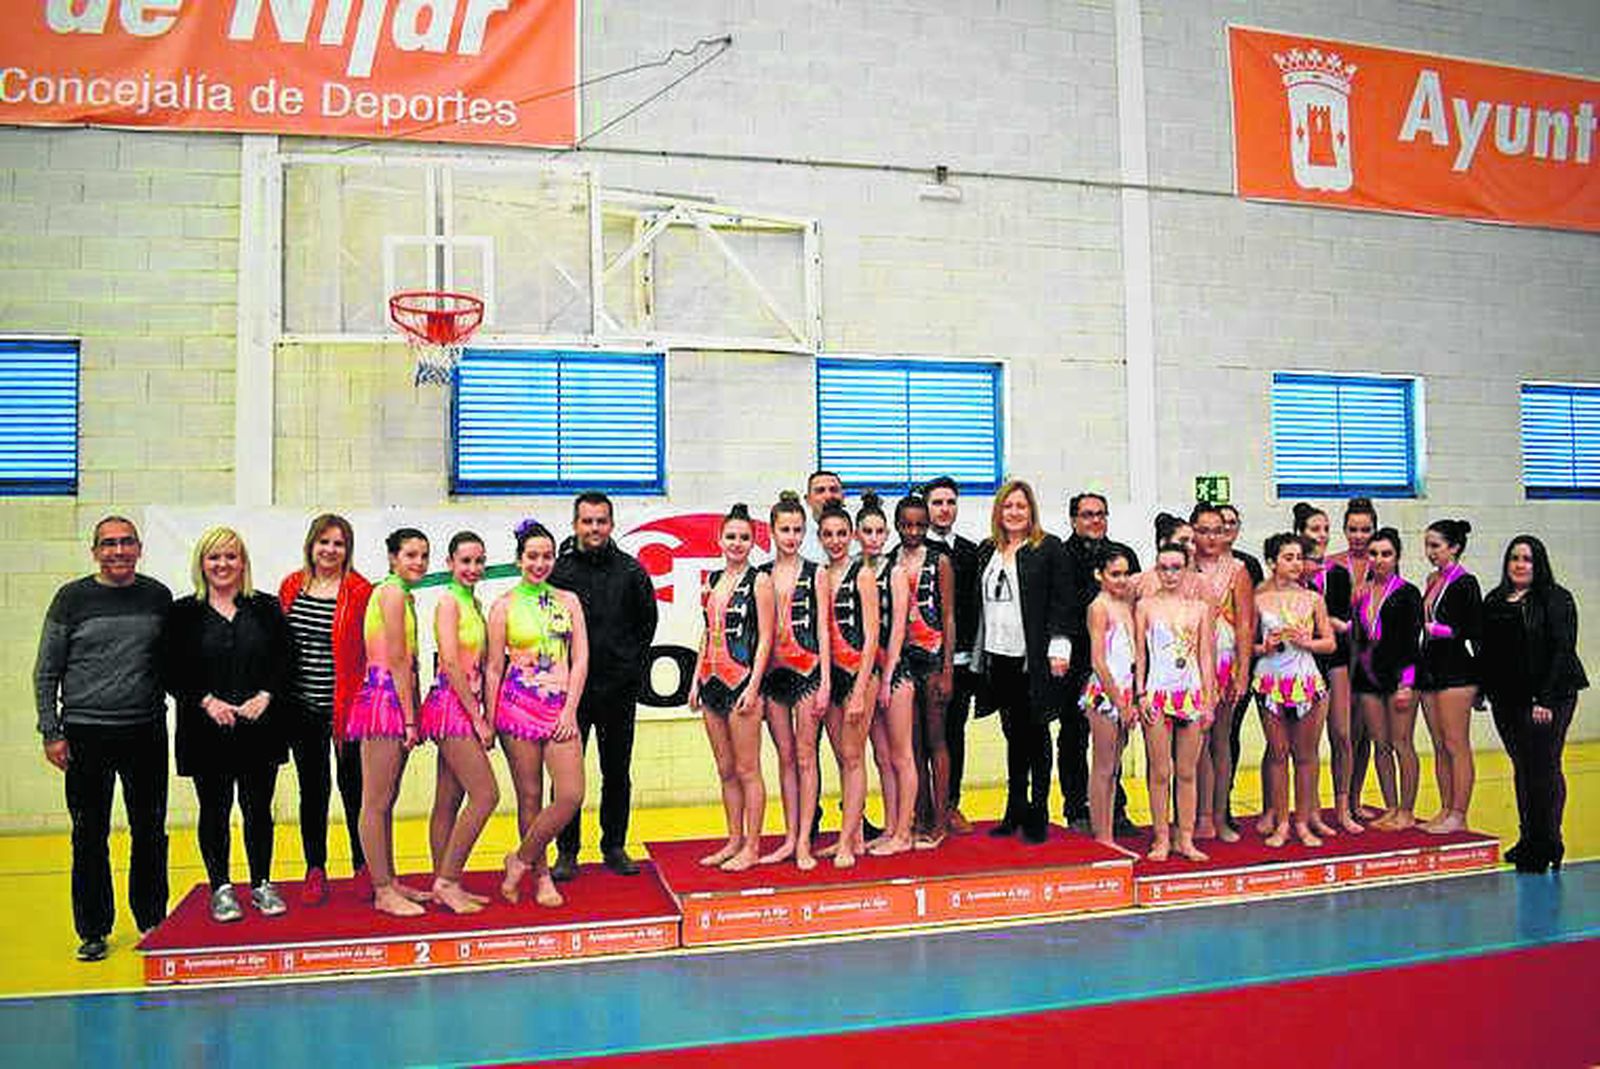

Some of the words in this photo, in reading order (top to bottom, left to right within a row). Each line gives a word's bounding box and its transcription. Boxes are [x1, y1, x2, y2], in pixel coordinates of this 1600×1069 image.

[0, 67, 234, 115] Concejalía
[250, 78, 304, 115] de
[321, 82, 519, 126] Deportes
[1398, 68, 1598, 173] Ayunt
[1324, 864, 1336, 882] 3
[915, 887, 926, 917] 1
[413, 942, 431, 964] 2
